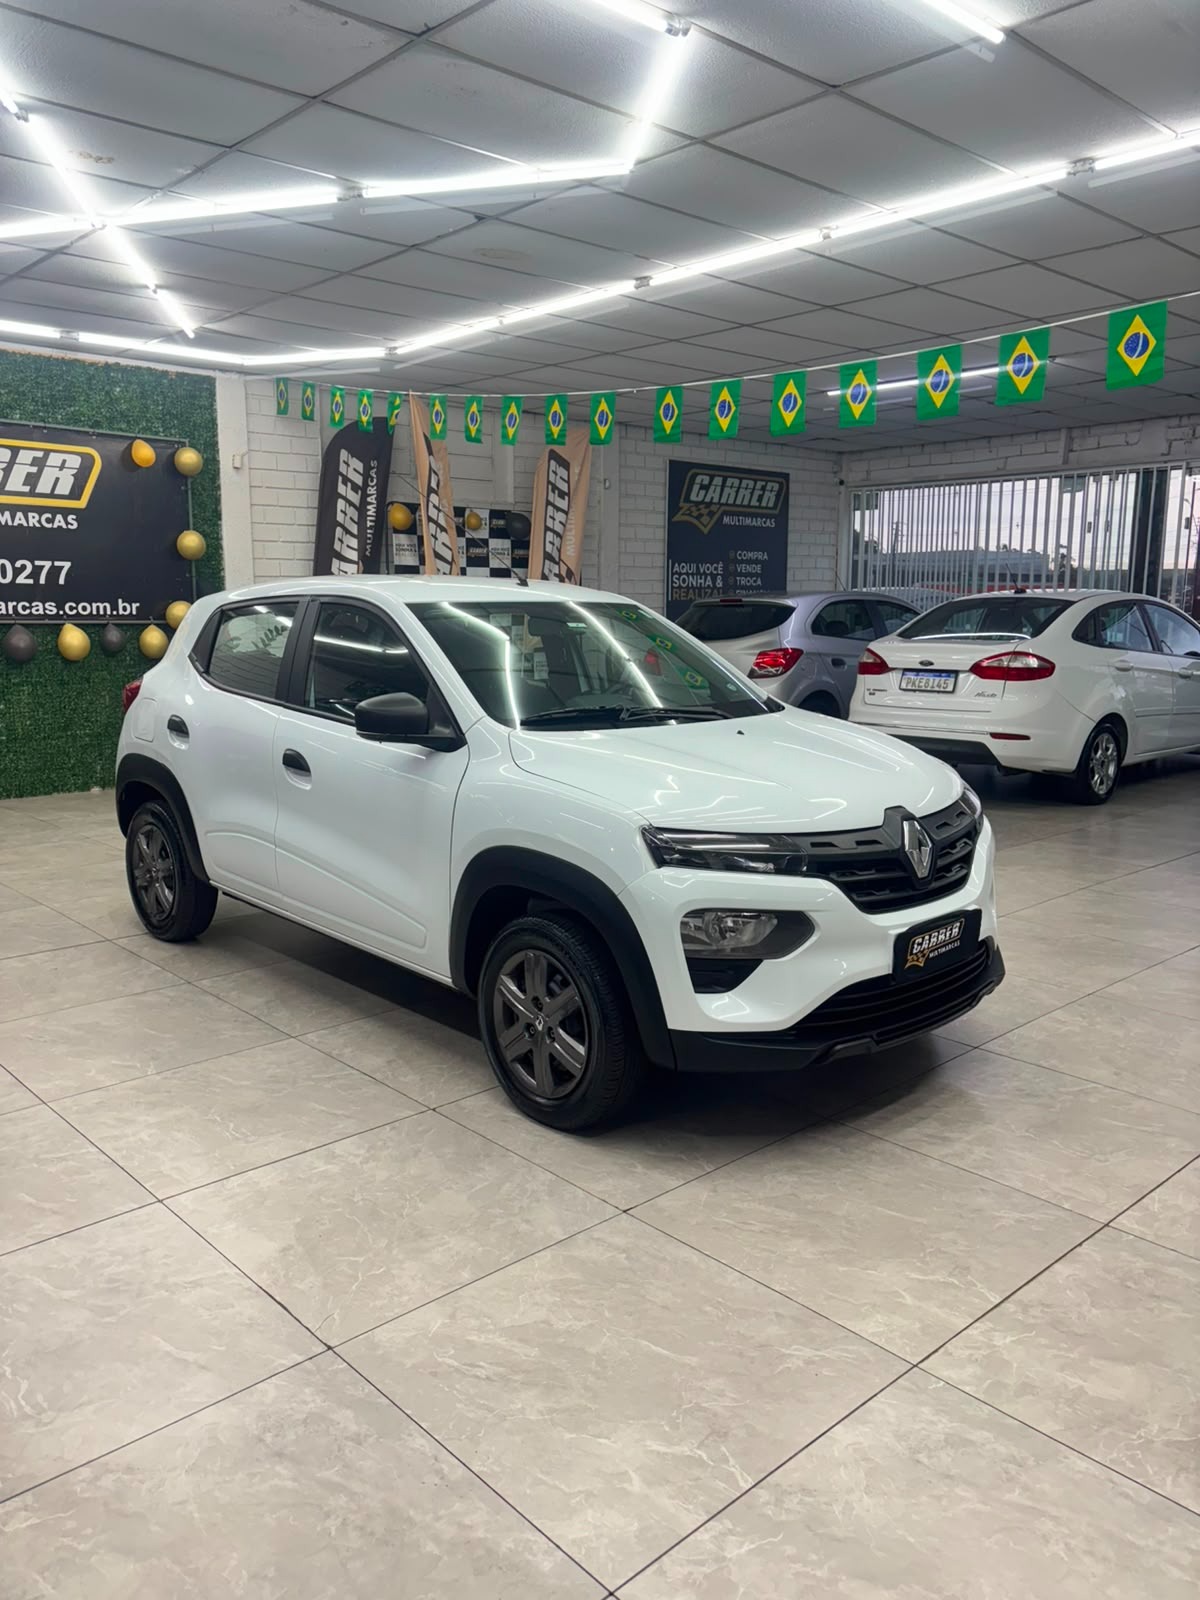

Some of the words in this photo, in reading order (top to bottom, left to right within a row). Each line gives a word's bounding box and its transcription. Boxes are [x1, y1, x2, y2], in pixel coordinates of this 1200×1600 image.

[690, 475, 779, 507] CARRER
[365, 459, 378, 557] MULTIMARCAS
[723, 516, 776, 528] MULTIMARCAS
[736, 551, 769, 561] COMPRA
[672, 562, 697, 574] AQUI
[698, 561, 724, 574] VOCÊ
[736, 564, 762, 574] VENDE
[672, 575, 713, 588] SONHA
[715, 576, 723, 588] &
[736, 577, 763, 586] TROCA
[912, 922, 960, 954] CARRER
